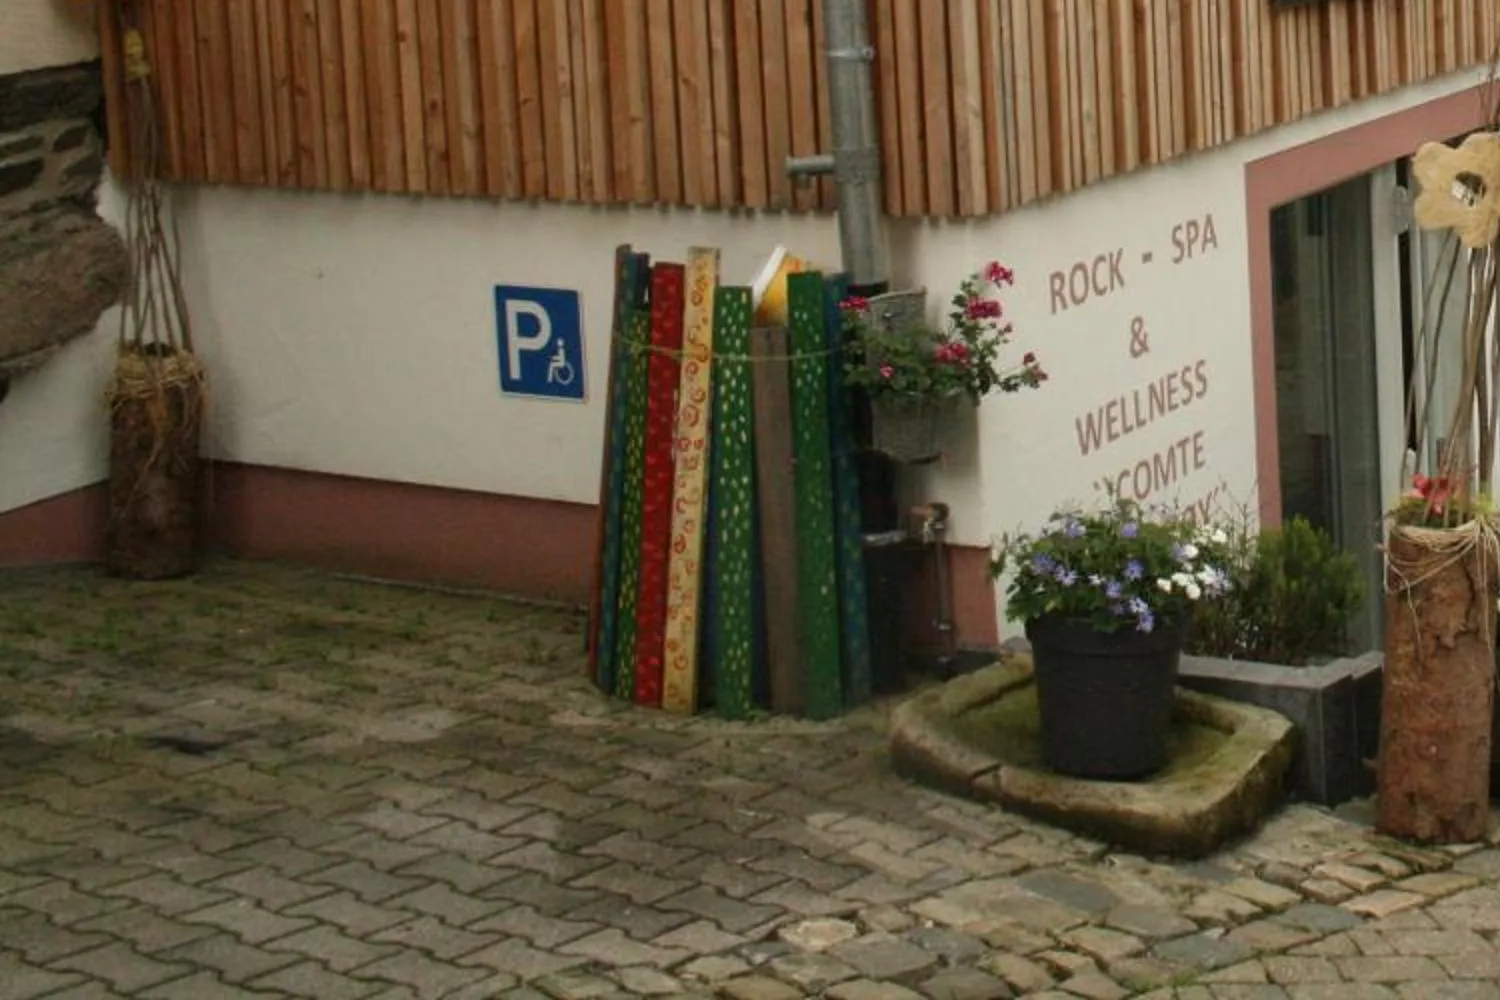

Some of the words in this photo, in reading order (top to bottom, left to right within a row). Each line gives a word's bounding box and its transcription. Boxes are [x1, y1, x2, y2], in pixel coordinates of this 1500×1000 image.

[1048, 246, 1126, 316] ROCK
[1170, 212, 1219, 266] SPA
[504, 298, 552, 381] P
[1128, 315, 1151, 360] &
[1074, 358, 1210, 457] WELLNESS
